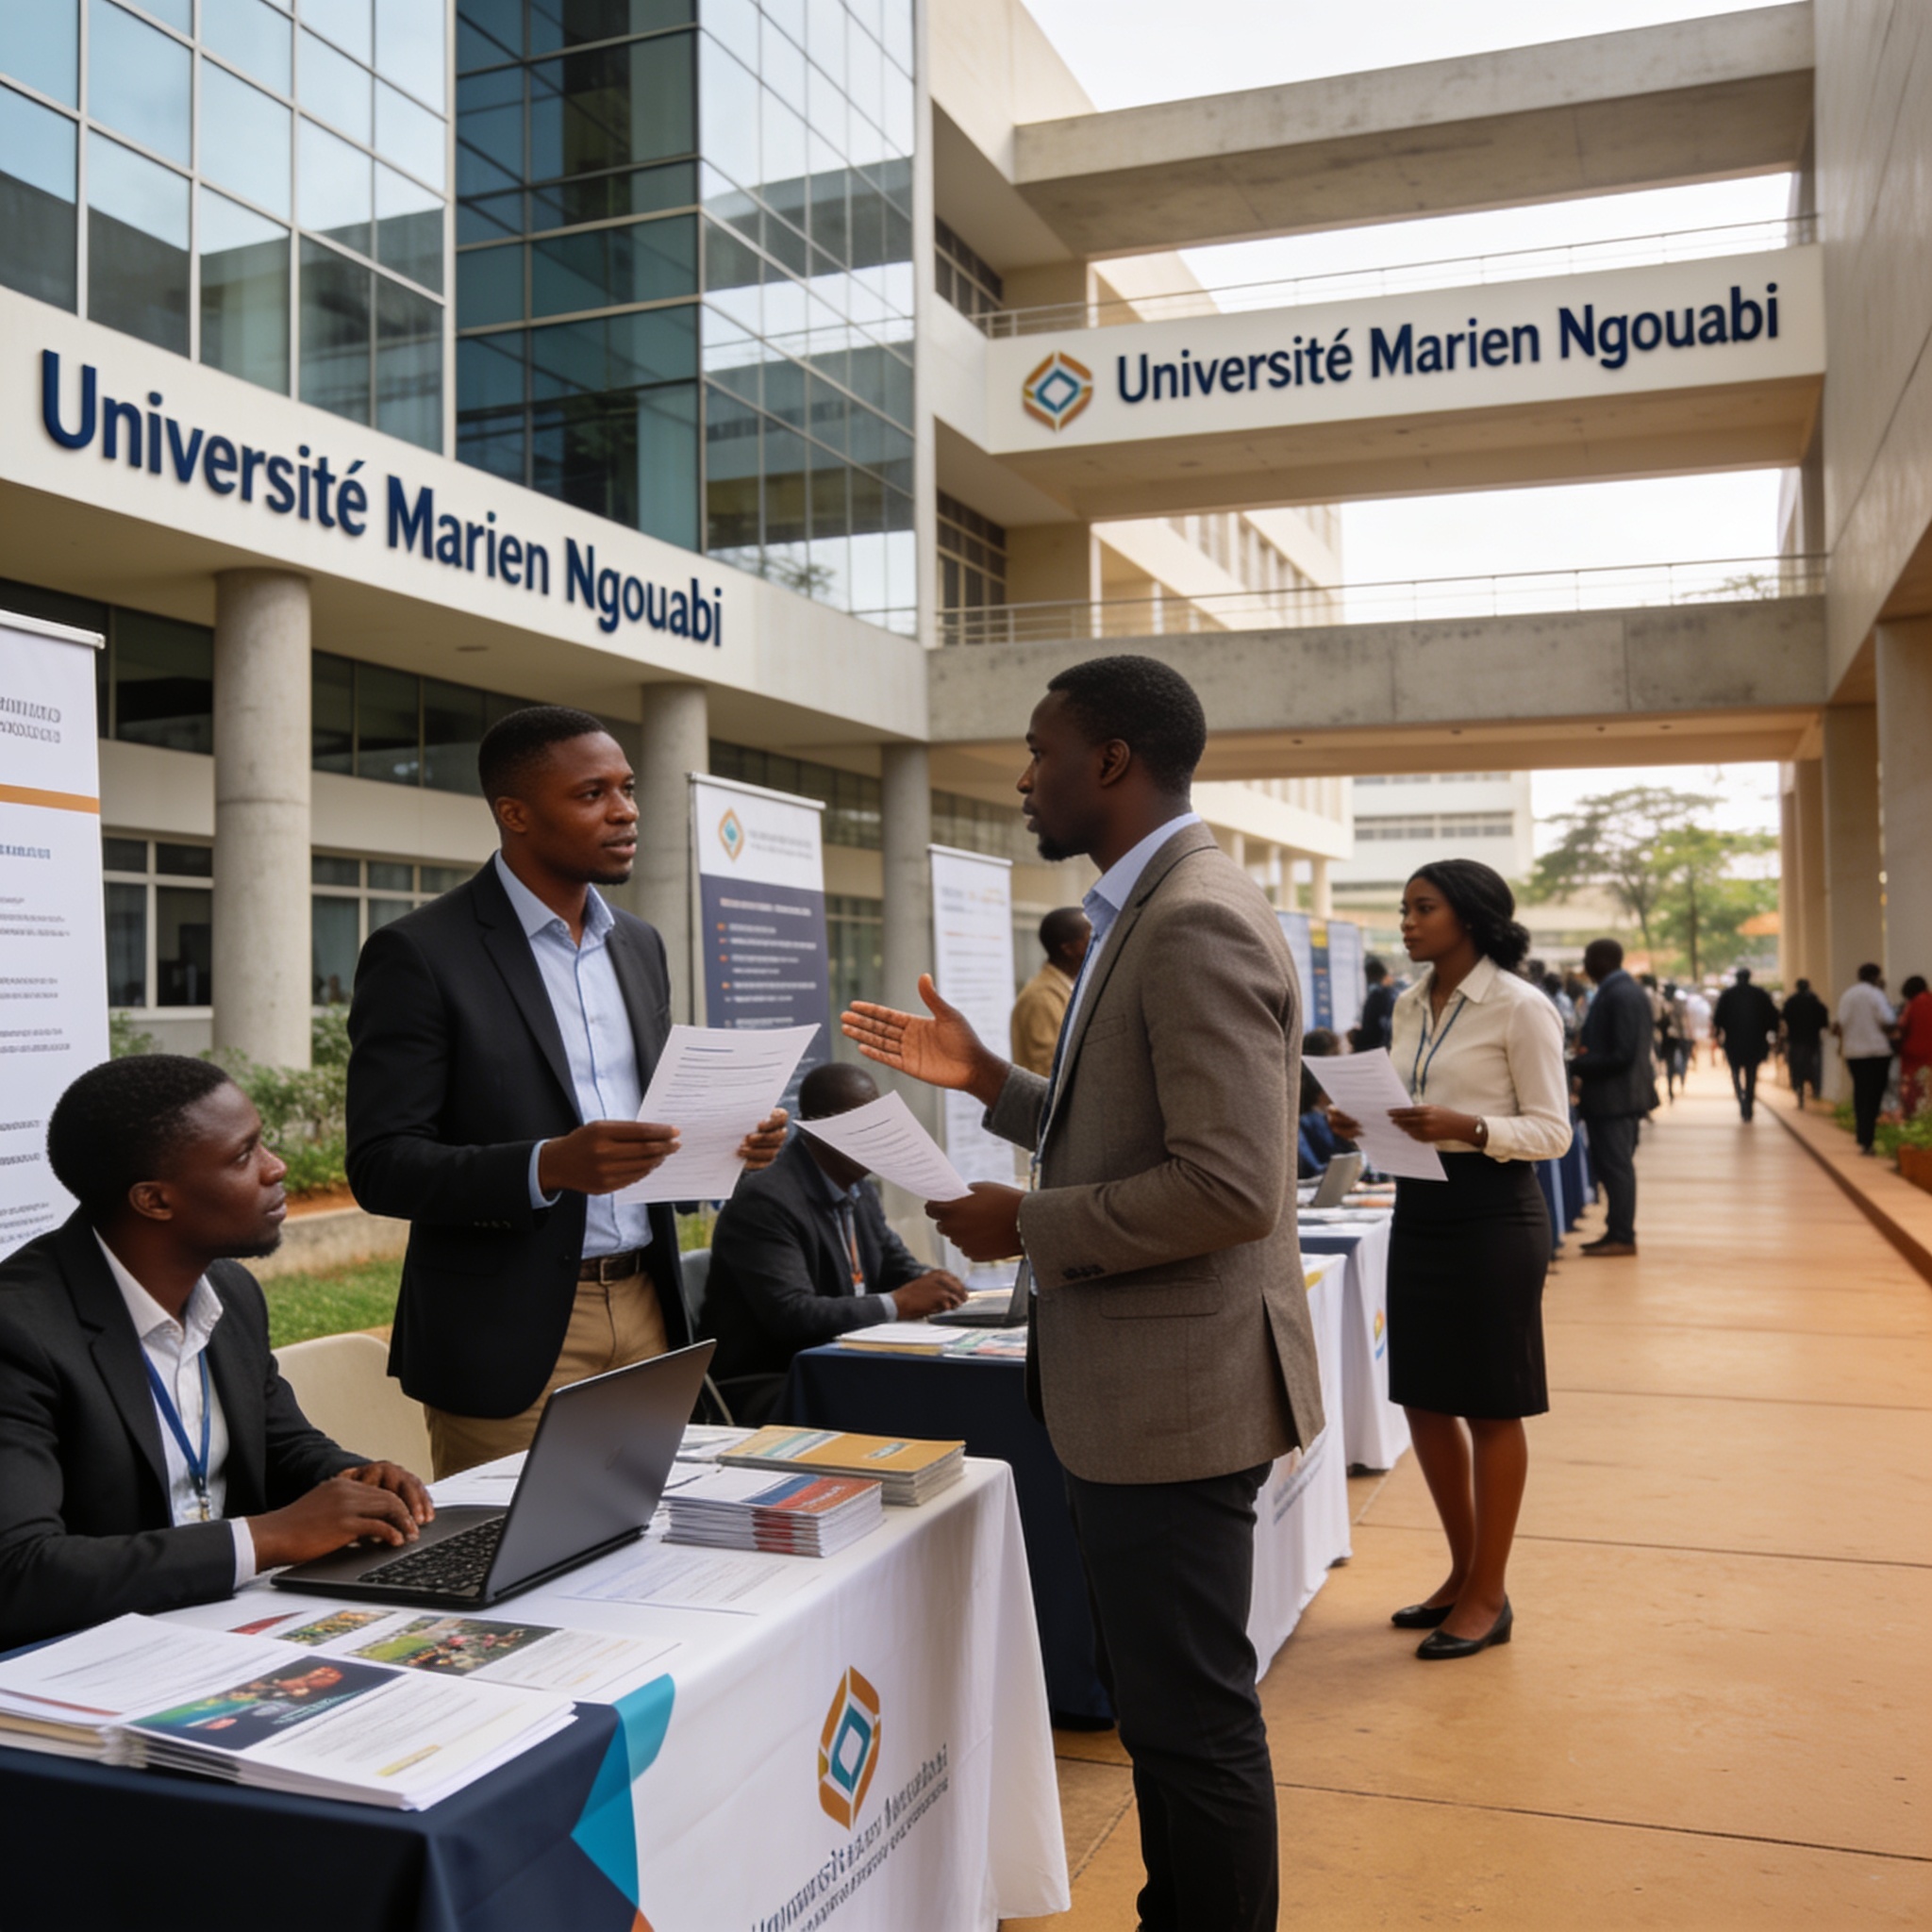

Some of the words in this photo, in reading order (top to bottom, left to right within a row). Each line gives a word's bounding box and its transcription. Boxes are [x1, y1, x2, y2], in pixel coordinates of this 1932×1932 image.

[1117, 327, 1353, 405] Université
[1370, 317, 1541, 379] Marien
[1557, 282, 1779, 371] Ngouabi
[41, 348, 368, 537] Université
[387, 475, 549, 595] Marien
[565, 537, 722, 647] Ngouabi
